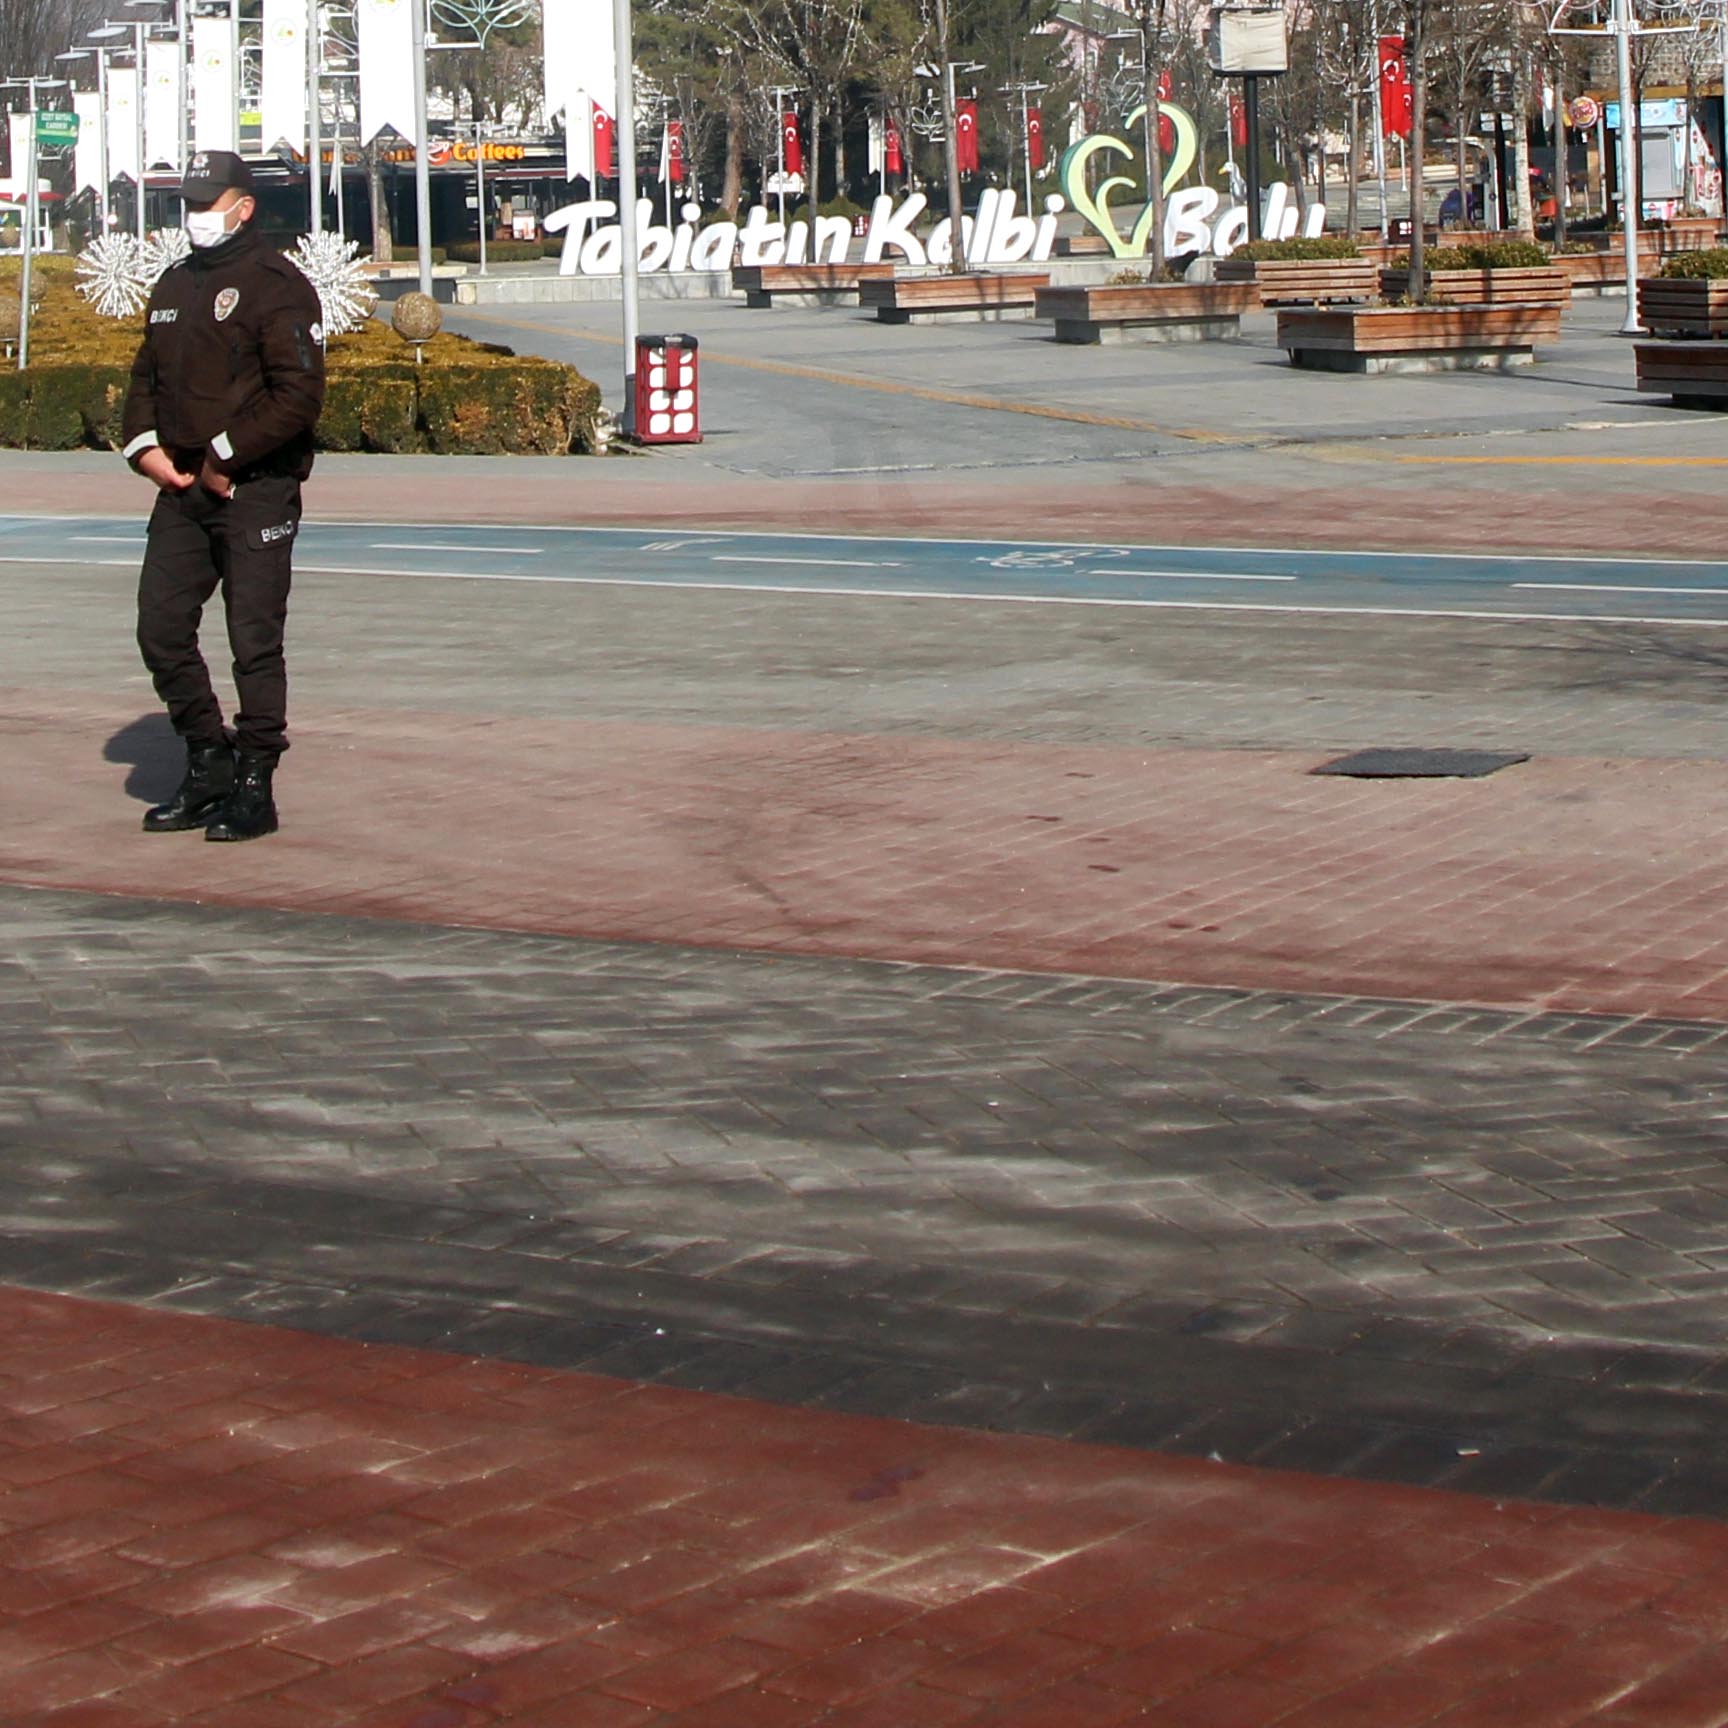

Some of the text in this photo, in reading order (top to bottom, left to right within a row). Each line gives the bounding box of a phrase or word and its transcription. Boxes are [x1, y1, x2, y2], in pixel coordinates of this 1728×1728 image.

[452, 141, 526, 162] Coffees
[543, 184, 1325, 276] Tabiatın Kalbi Bolu
